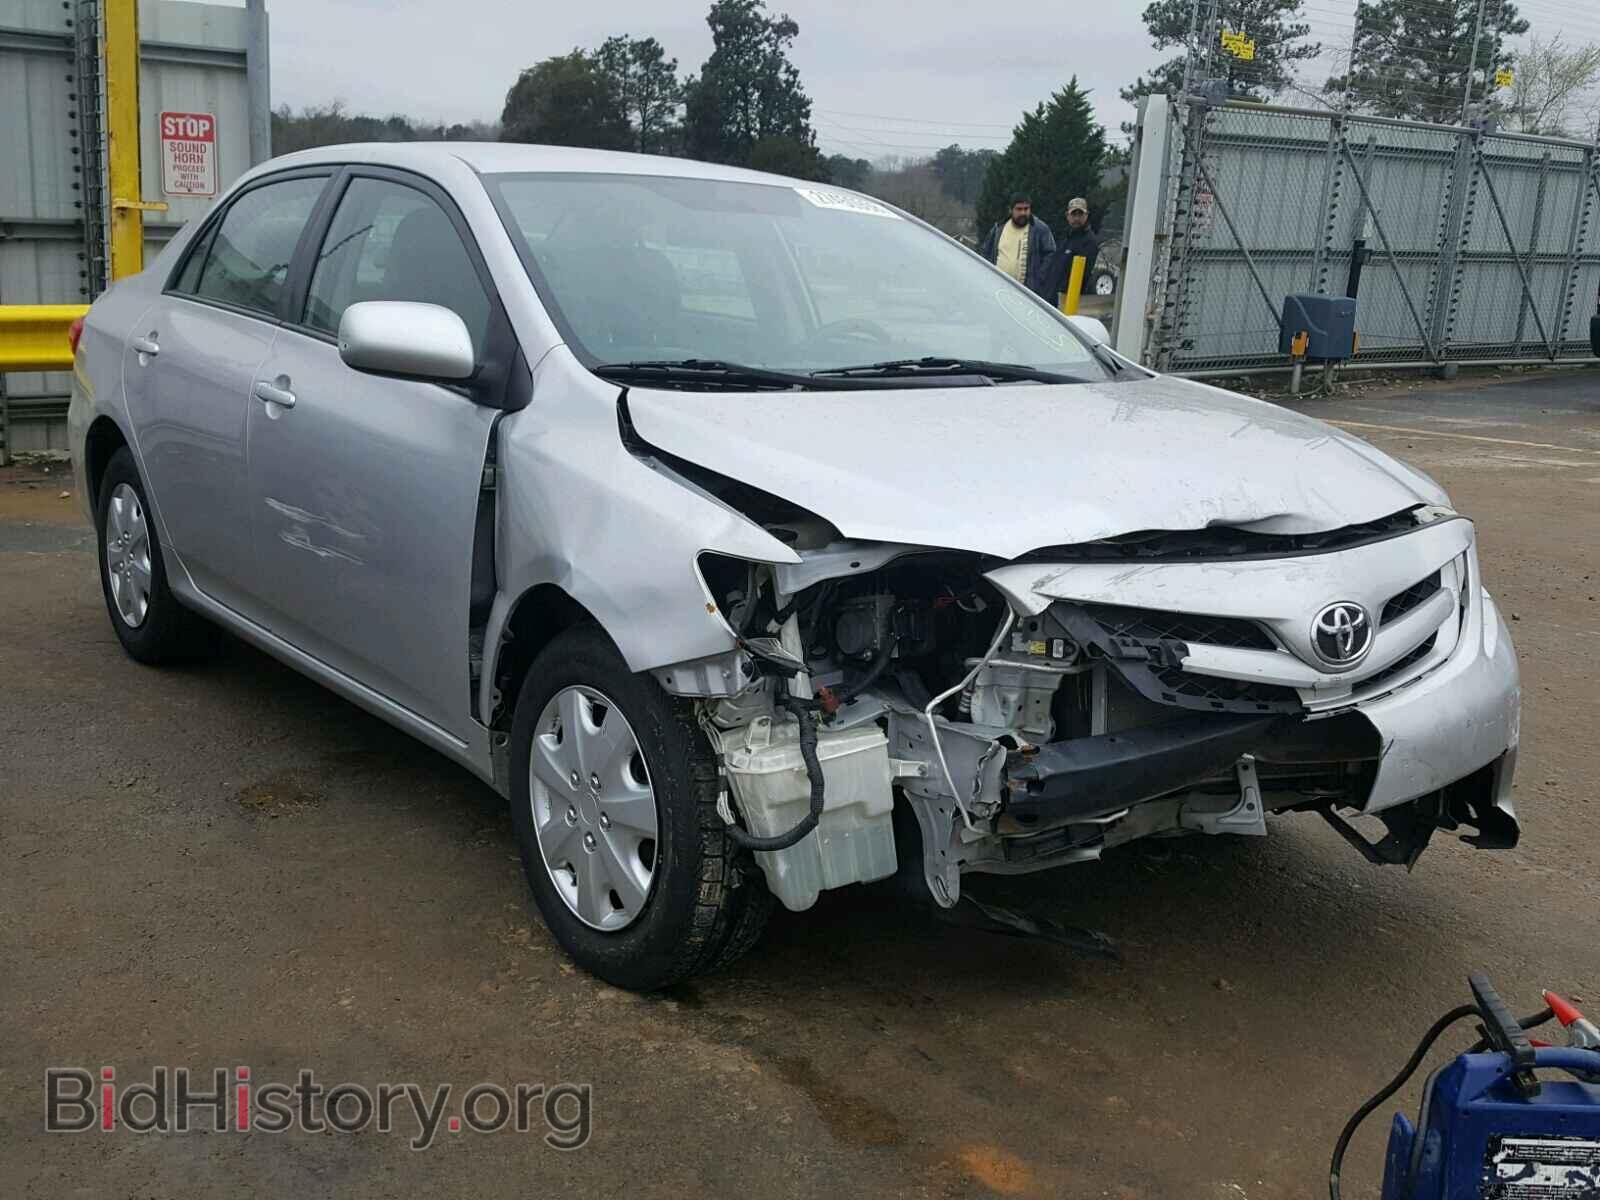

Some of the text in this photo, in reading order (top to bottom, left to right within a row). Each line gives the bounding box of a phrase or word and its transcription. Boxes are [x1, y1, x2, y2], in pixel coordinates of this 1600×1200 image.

[164, 117, 209, 137] STOP
[170, 142, 207, 154] SOUND
[174, 153, 204, 164] HORN
[174, 180, 206, 189] CAUTION
